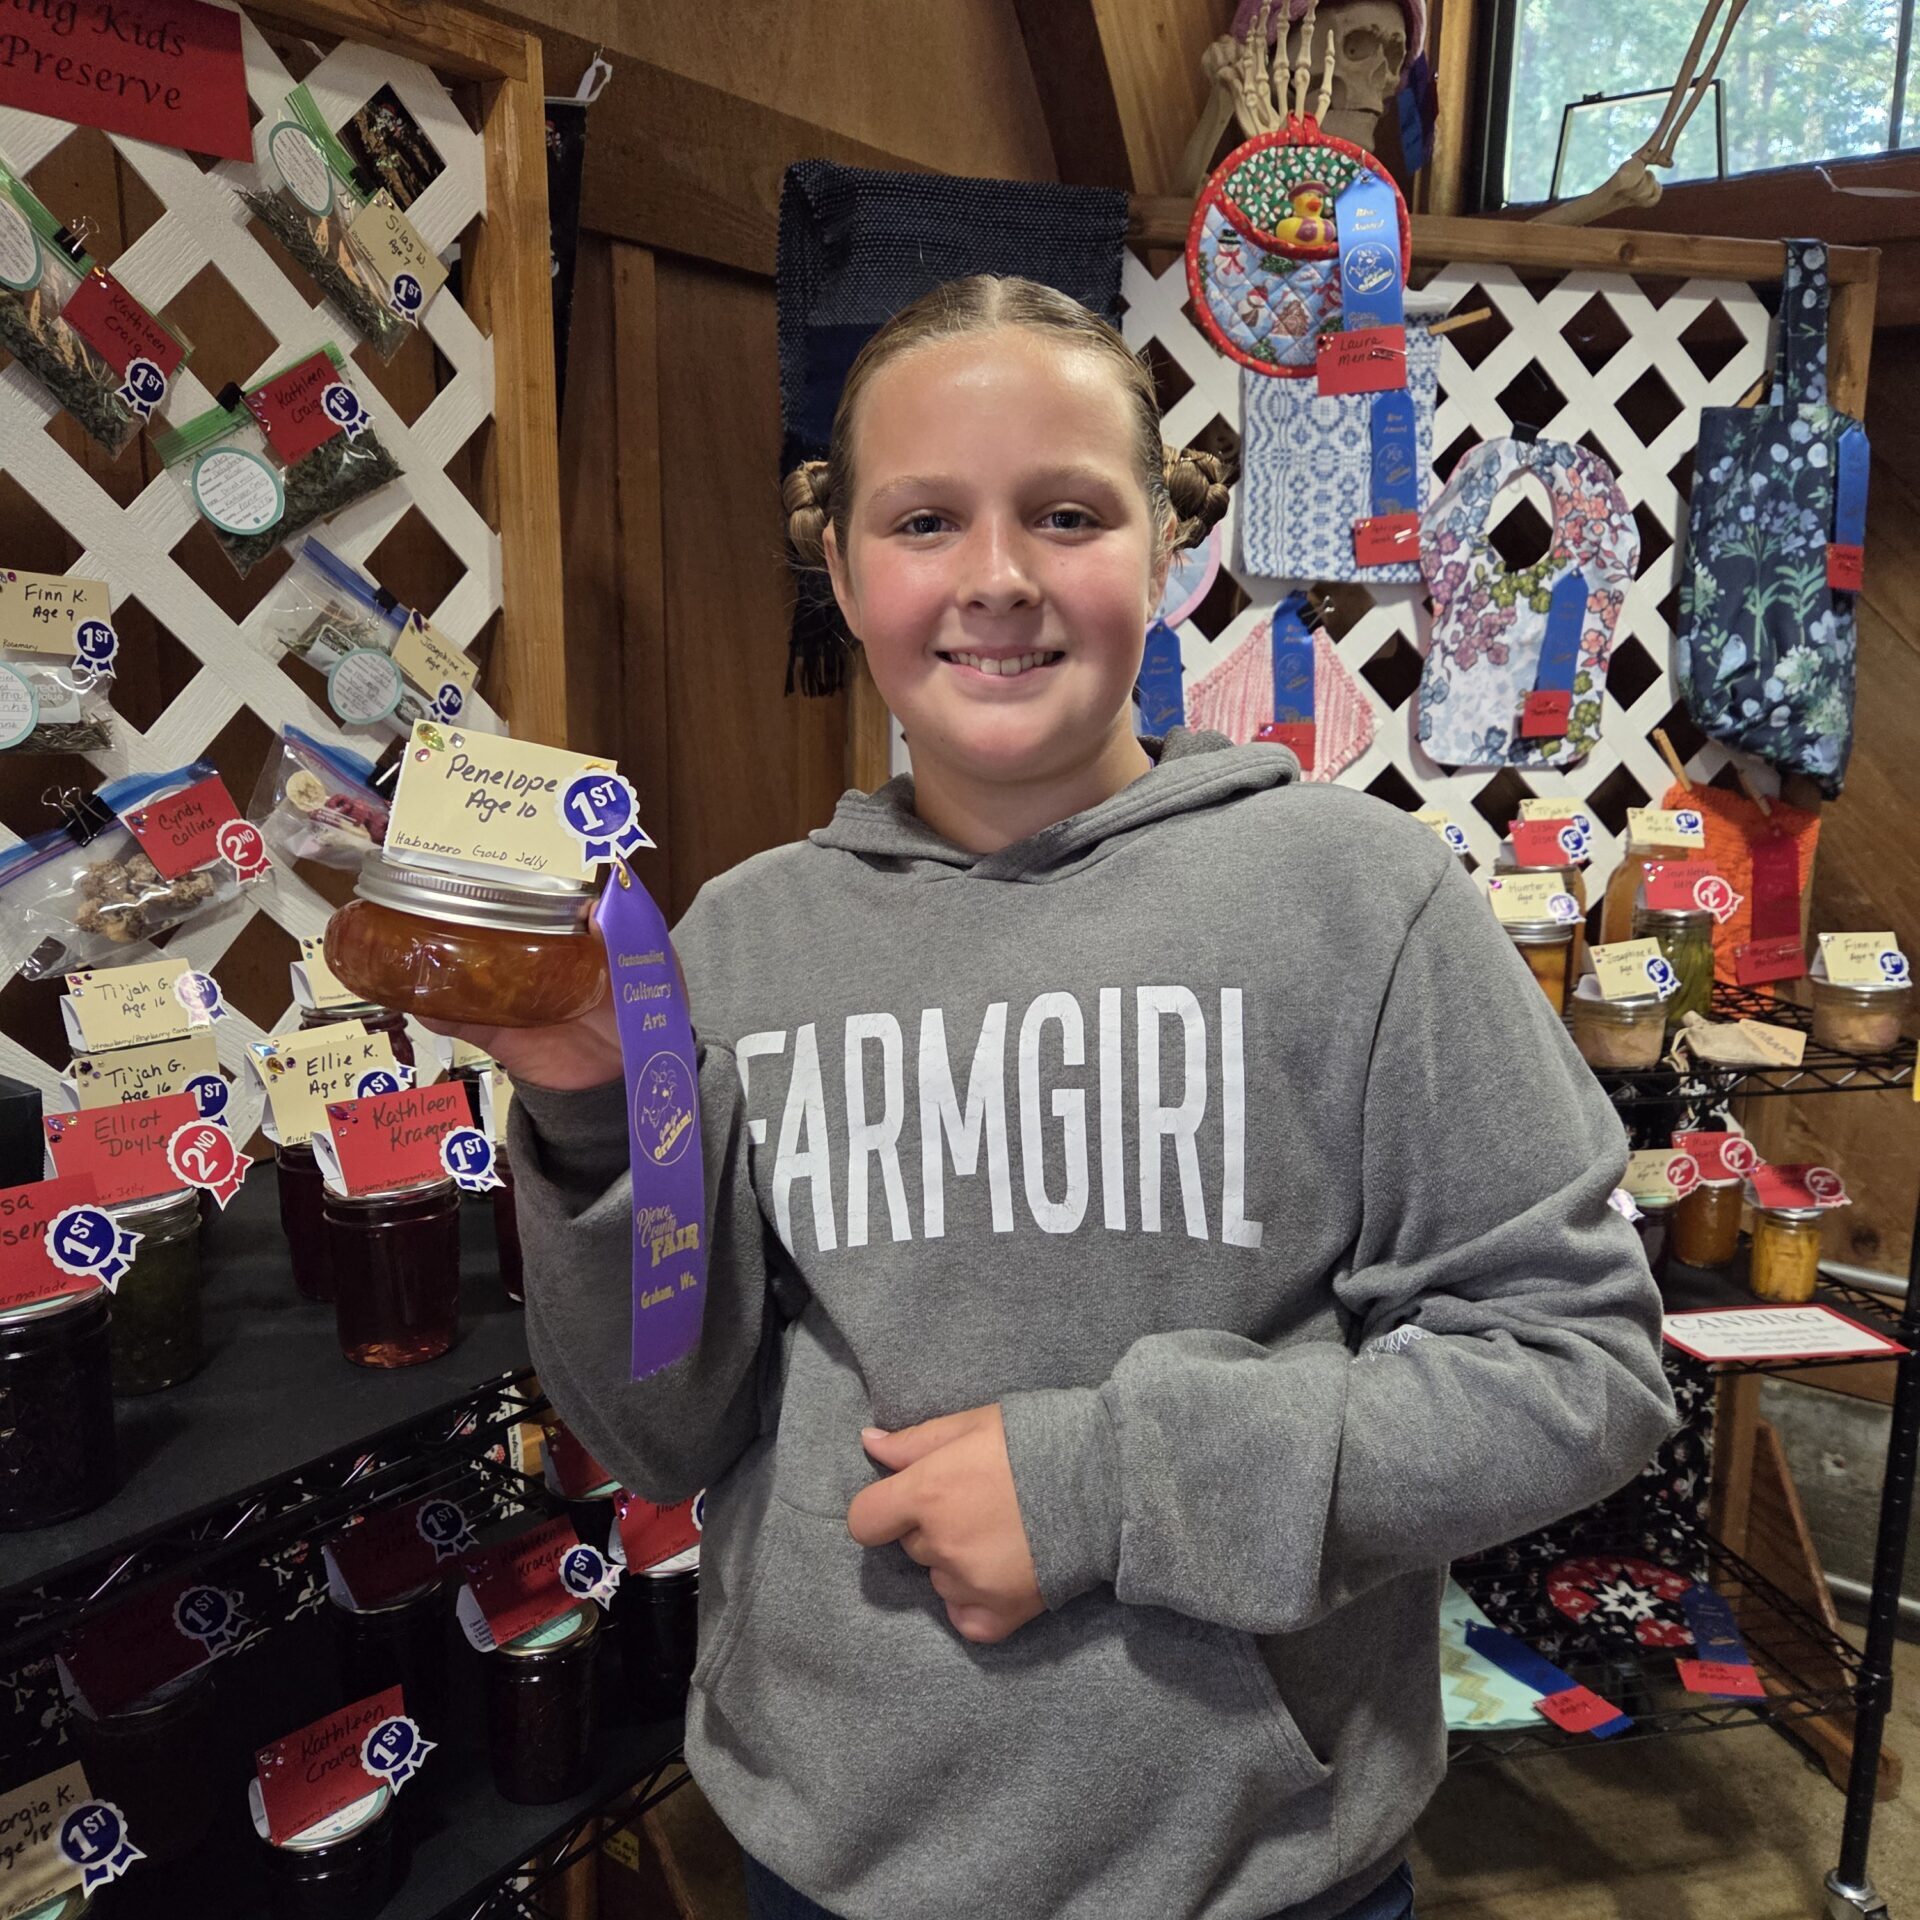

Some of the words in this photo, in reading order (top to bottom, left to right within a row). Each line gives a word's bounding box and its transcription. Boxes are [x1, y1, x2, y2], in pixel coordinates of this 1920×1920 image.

[92, 4, 186, 56] Kids
[0, 34, 182, 110] Preserve
[385, 214, 414, 253] Silas
[388, 239, 404, 256] Age
[402, 259, 411, 267] 7
[395, 279, 420, 302] 1ST
[104, 316, 142, 359] Craig
[109, 294, 167, 355] Kathleen
[132, 367, 162, 391] 1ST
[275, 367, 326, 410] Kathleen
[329, 388, 350, 420] 1ST
[25, 584, 63, 601] Finn
[32, 605, 58, 623] Age
[66, 609, 75, 621] 9
[82, 627, 110, 652] 1ST
[425, 656, 441, 672] Age
[440, 688, 462, 708] 1ST
[446, 753, 560, 797] Penelope
[158, 801, 204, 832] Cyndy
[465, 788, 512, 823] Age
[517, 801, 537, 819] 10
[571, 780, 618, 832] 1ST
[172, 817, 216, 847] Collins
[225, 829, 256, 862] 2ND
[395, 831, 462, 856] Habanero
[516, 854, 549, 871] Jelly
[122, 1002, 146, 1018] Age
[154, 996, 166, 1008] 16
[623, 981, 672, 1004] Culinary
[642, 1012, 667, 1032] Arts
[167, 1059, 186, 1073] G.
[306, 1053, 353, 1076] Ellie
[157, 1082, 171, 1095] 16
[309, 1079, 337, 1098] Age
[344, 1073, 355, 1087] 8
[94, 1110, 162, 1140] Elliot
[373, 1094, 457, 1129] Kathleen
[736, 985, 1263, 1259] FARMGIRL
[100, 1133, 169, 1158] Doyle
[391, 1118, 457, 1151] Kraeger
[181, 1130, 217, 1180] 2ND
[451, 1137, 483, 1171] 1ST
[0, 1194, 34, 1216] sa
[637, 1204, 671, 1234] Pierce
[62, 1213, 101, 1264] 1ST
[641, 1213, 677, 1248] County
[651, 1223, 700, 1267] FAIR
[1670, 1310, 1825, 1332] CANNING
[425, 1506, 455, 1539] 1ST
[500, 1526, 557, 1566] Kathleen
[571, 1550, 595, 1591] 1ST
[185, 1592, 216, 1632] 1ST
[301, 1702, 385, 1763] Kathleen
[372, 1722, 403, 1768] 1ST
[306, 1743, 361, 1784] Craig
[57, 1784, 75, 1806] K.
[67, 1809, 107, 1860] 1ST
